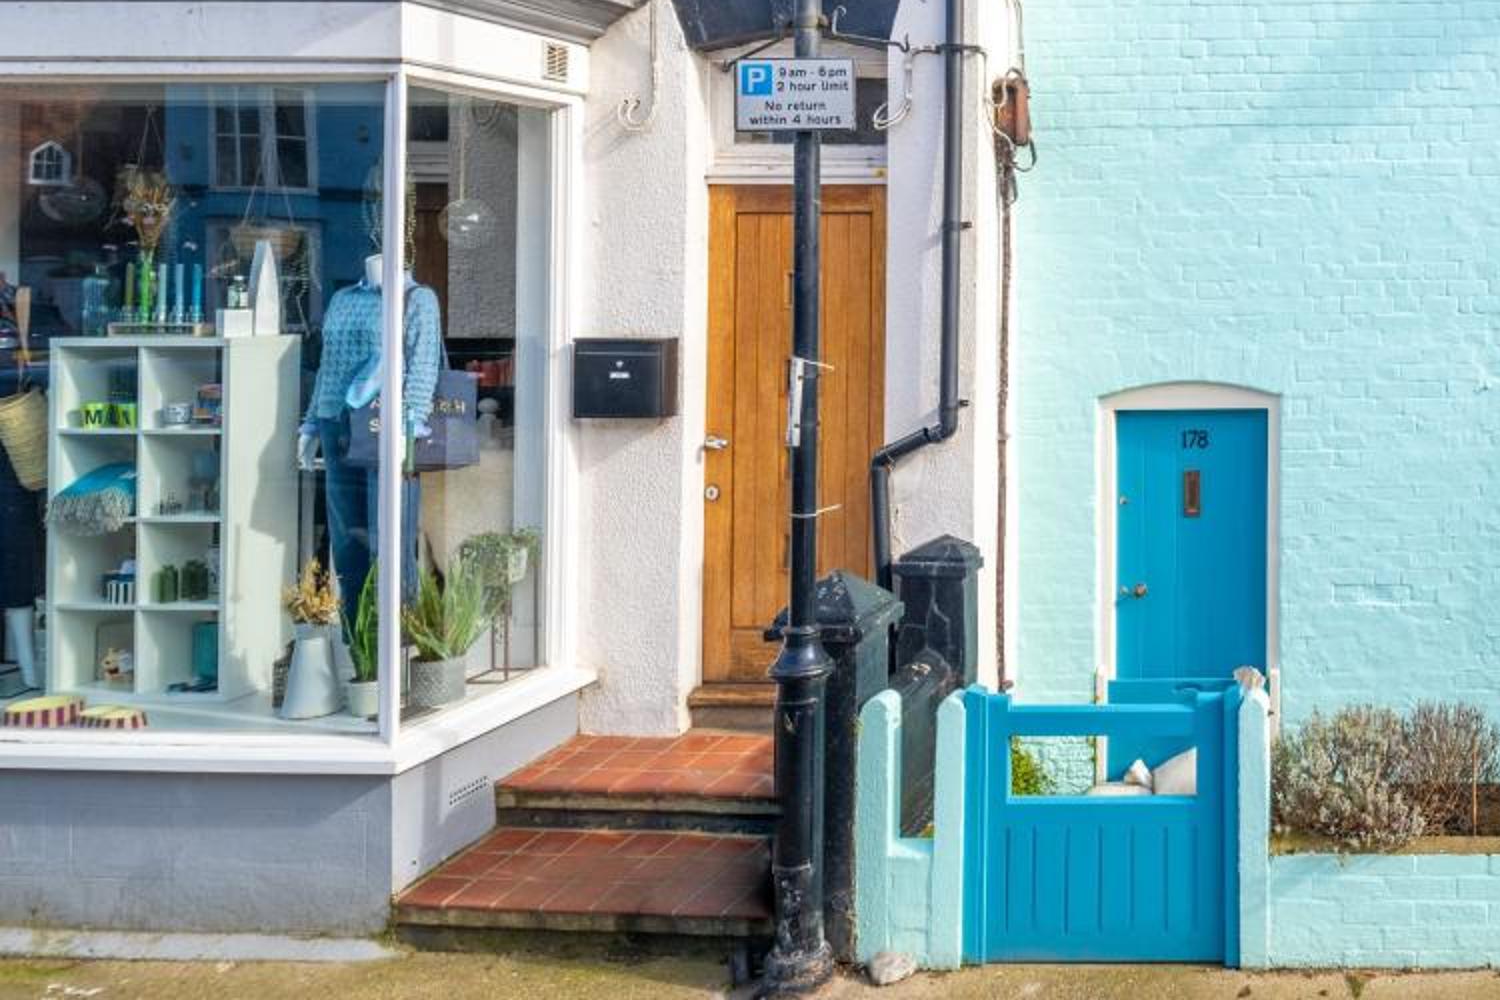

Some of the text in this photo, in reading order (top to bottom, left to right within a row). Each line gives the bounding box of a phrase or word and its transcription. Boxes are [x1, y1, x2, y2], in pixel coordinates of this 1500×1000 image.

[747, 67, 767, 93] P
[776, 81, 849, 92] 2 hour limit
[765, 101, 826, 111] No return
[749, 115, 841, 125] within 4 hours
[1183, 430, 1208, 448] 178
